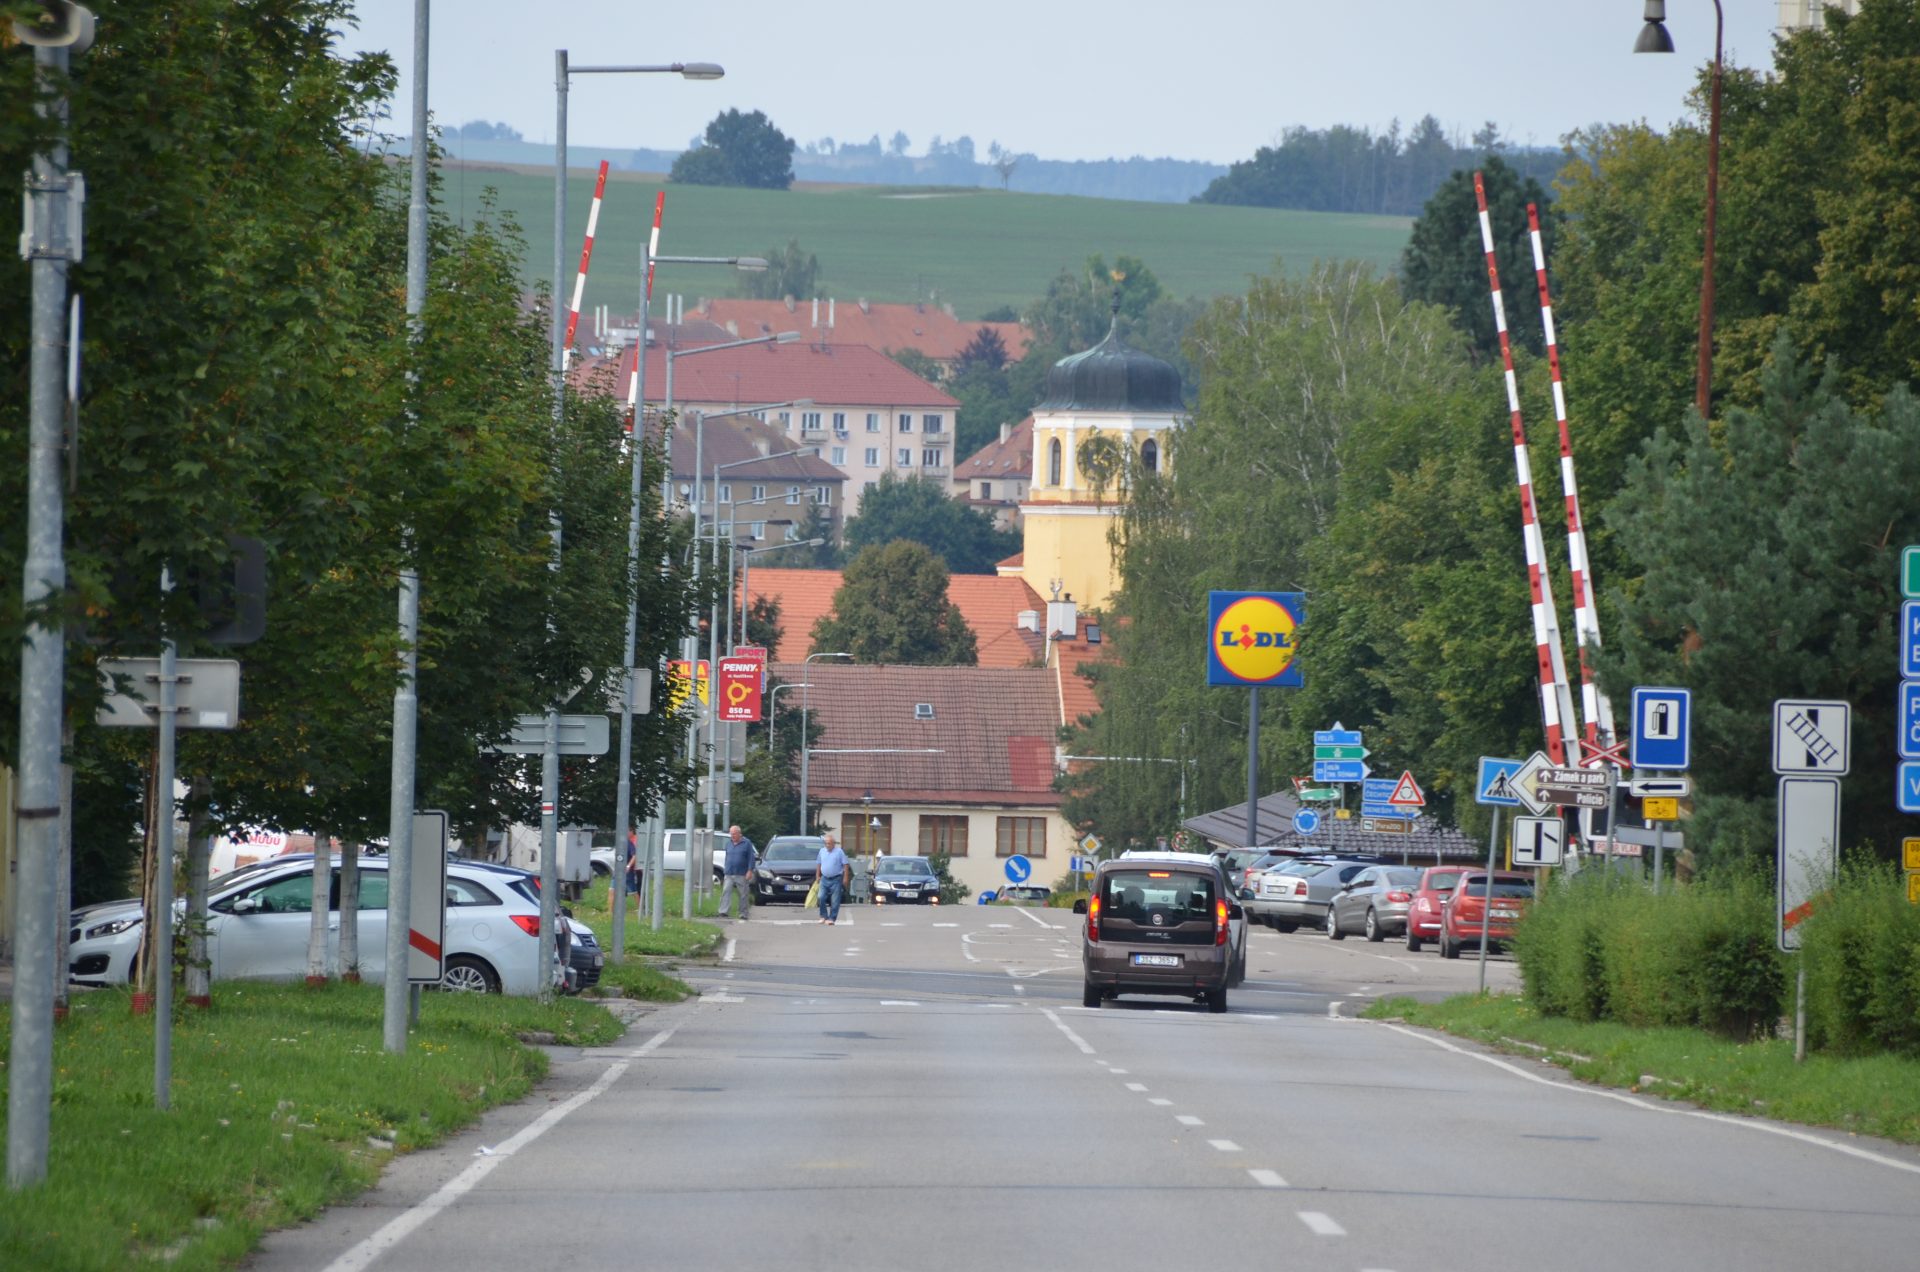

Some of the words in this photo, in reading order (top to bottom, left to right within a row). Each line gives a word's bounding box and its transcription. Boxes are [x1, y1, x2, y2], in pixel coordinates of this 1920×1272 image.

[1221, 624, 1291, 651] LIDL
[735, 648, 766, 657] SPORT
[1554, 771, 1580, 783] Zámek
[1581, 774, 1586, 783] a
[1587, 772, 1605, 785] park
[1577, 793, 1603, 805] Policie
